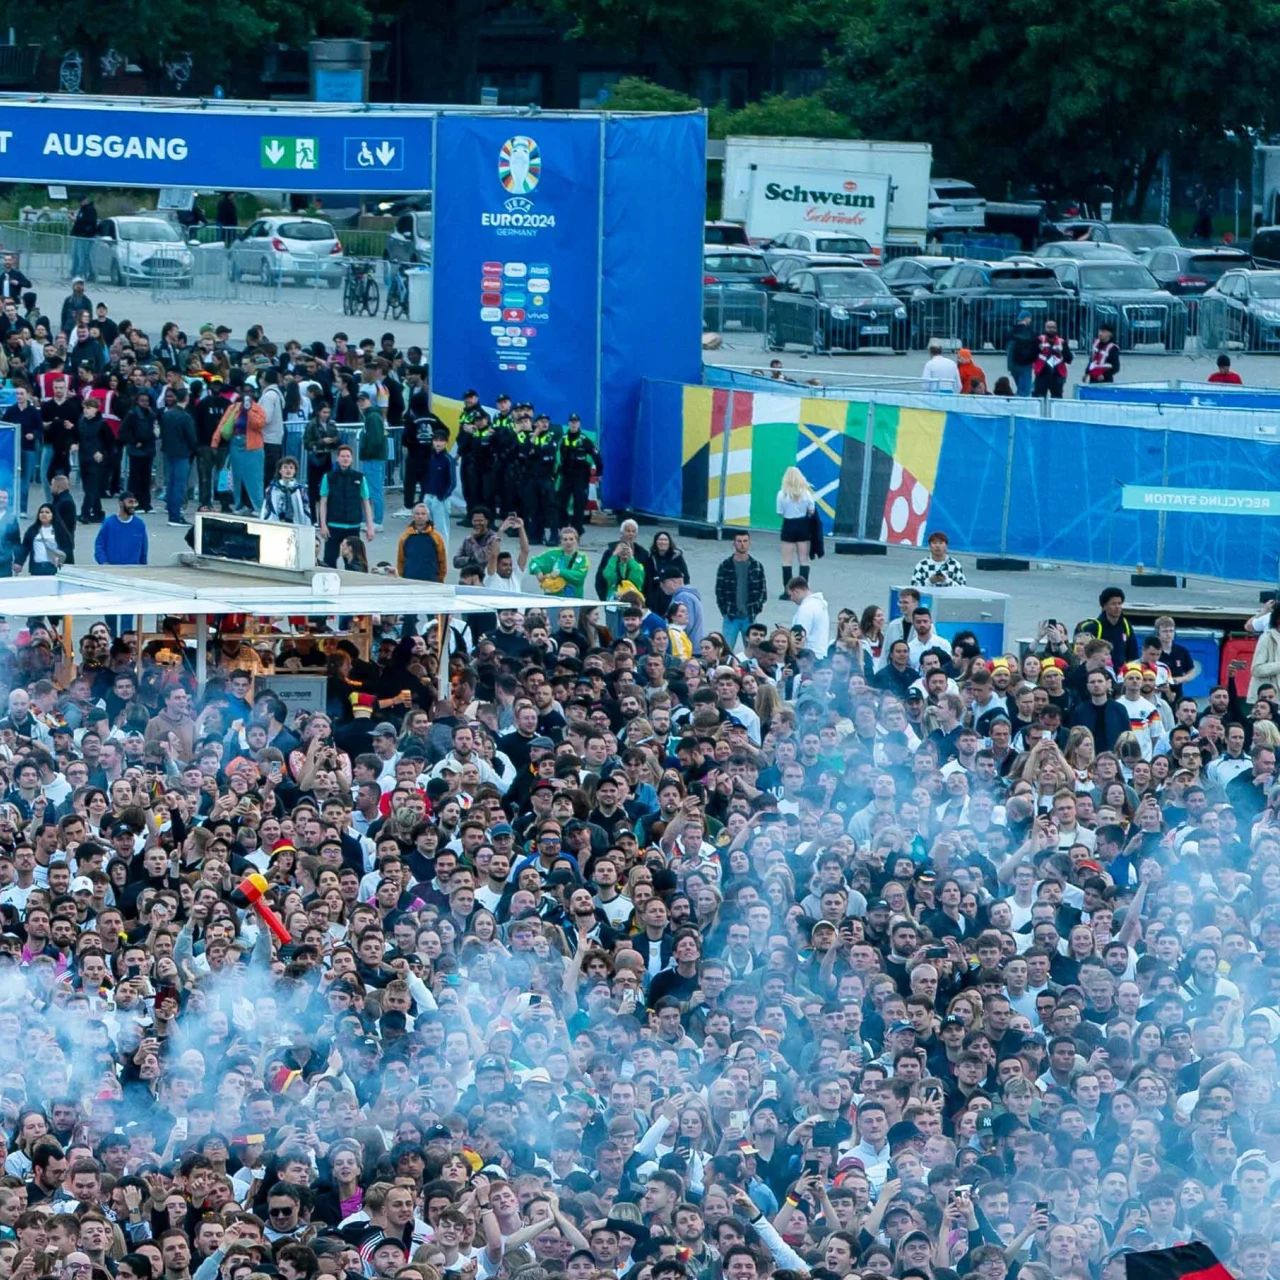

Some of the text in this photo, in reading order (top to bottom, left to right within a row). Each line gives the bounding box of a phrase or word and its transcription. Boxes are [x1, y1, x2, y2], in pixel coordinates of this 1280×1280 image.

[43, 133, 188, 161] AUSGANG
[504, 197, 534, 212] UEFA
[765, 183, 875, 208] Schweim
[481, 213, 556, 228] EURO2024
